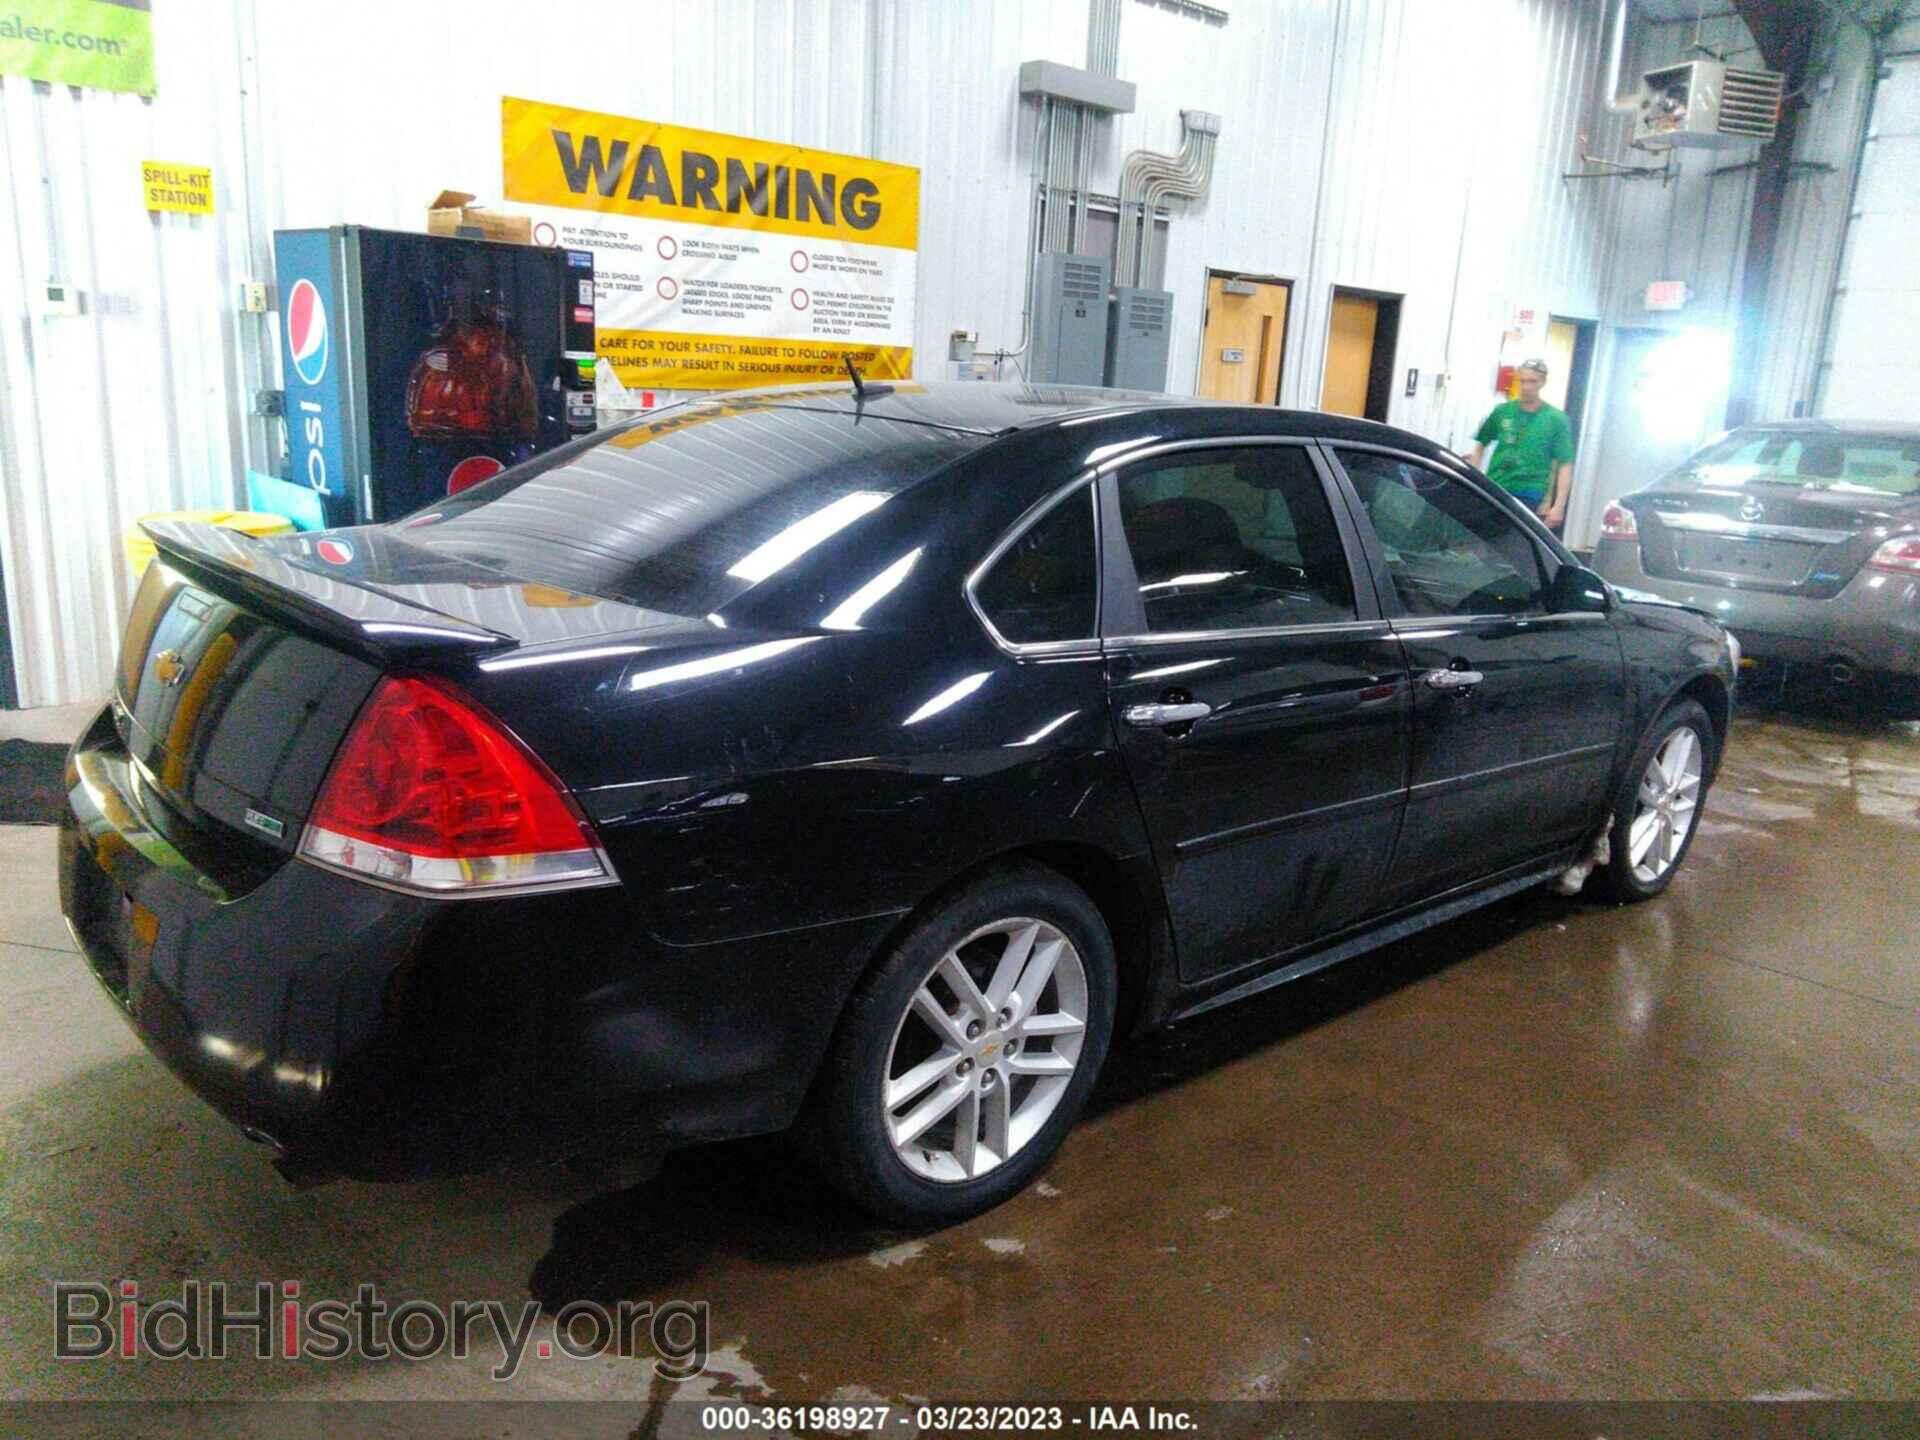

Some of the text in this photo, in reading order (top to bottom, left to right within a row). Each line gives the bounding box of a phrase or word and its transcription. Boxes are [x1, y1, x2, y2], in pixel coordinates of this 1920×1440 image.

[0, 16, 121, 56] aler.com
[144, 168, 210, 188] SPILL-KIT
[551, 129, 882, 231] WARNING
[151, 188, 207, 207] STATION
[579, 228, 618, 239] ATTENTION
[619, 232, 628, 240] TO
[562, 237, 643, 251] YOUR SURROUNDINGS
[682, 240, 699, 248] LOOK
[611, 272, 640, 281] SHOULD
[615, 283, 643, 292] STARTED
[730, 301, 744, 309] AND
[600, 338, 876, 362] CARE FOR YOUR SAFETY. FAILURE TO FOLLOW POSTED
[599, 356, 649, 368] ELINES
[652, 357, 678, 369] MAY
[682, 358, 719, 371] RESULT
[722, 360, 735, 371] IN
[738, 361, 781, 374] SERIOUS
[783, 363, 817, 374] INJURY
[820, 364, 835, 375] OR
